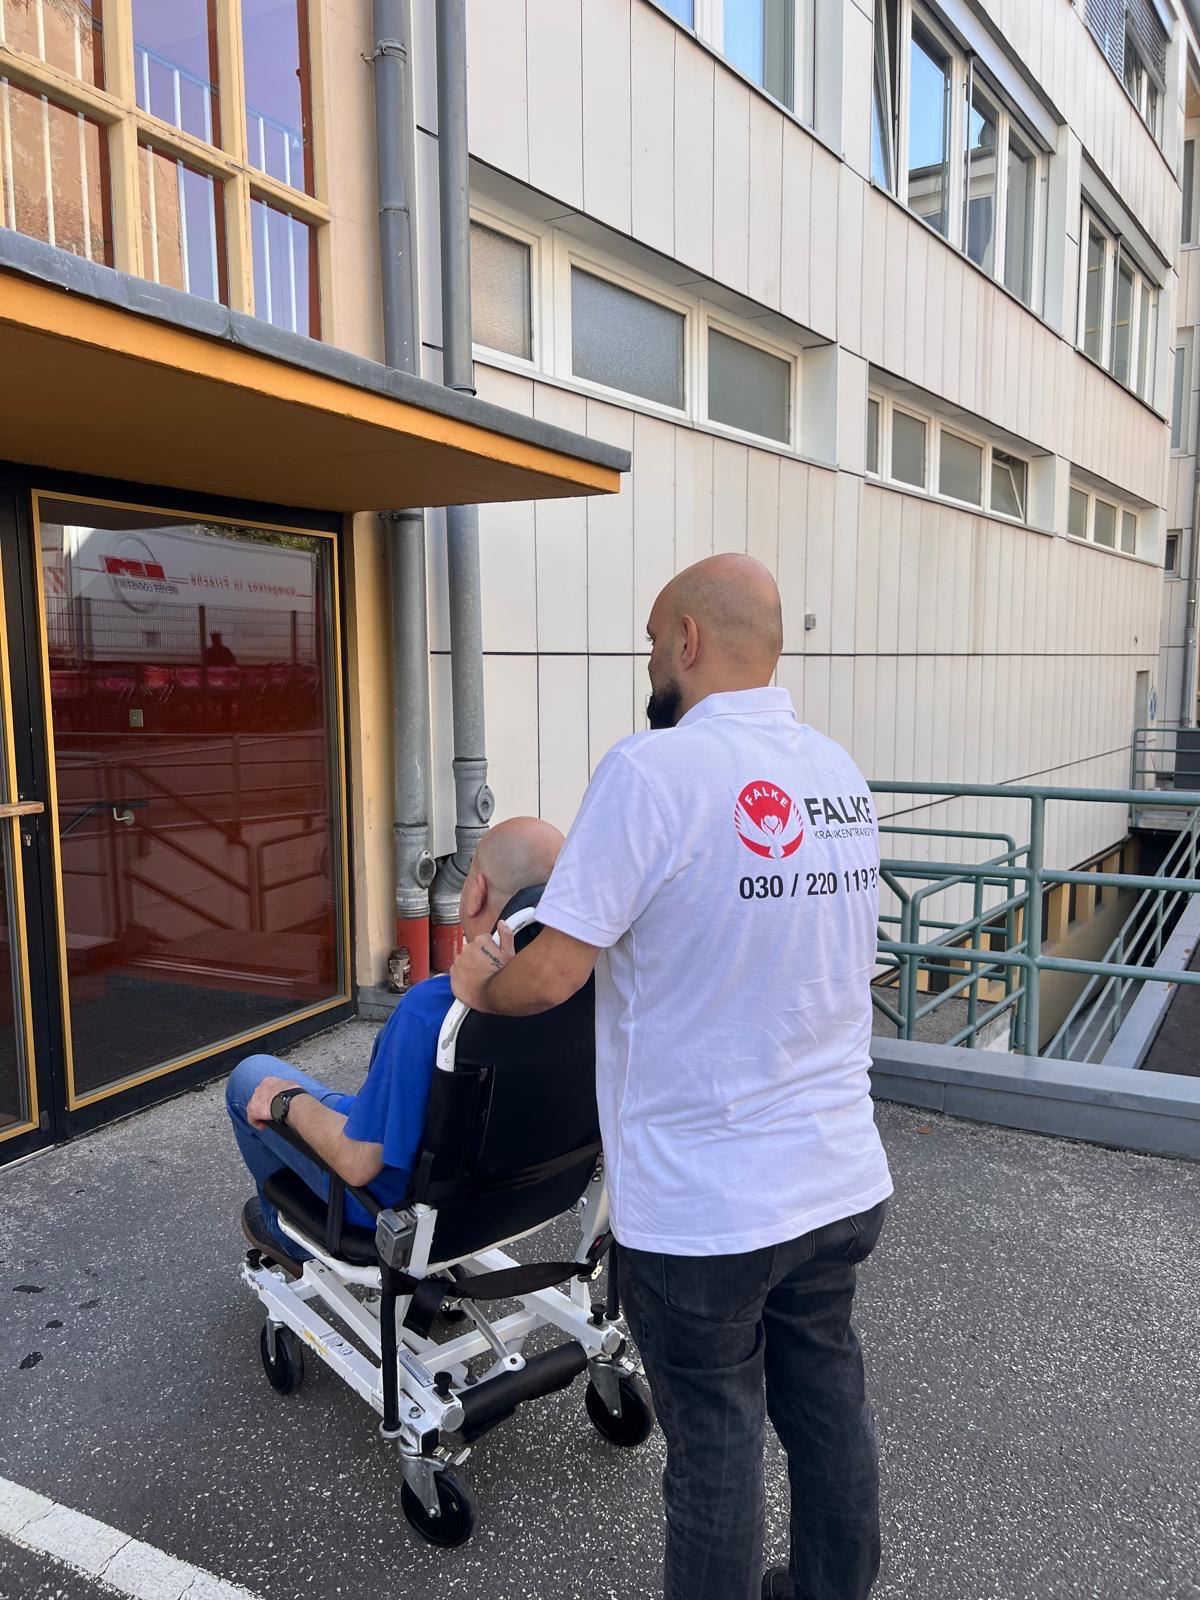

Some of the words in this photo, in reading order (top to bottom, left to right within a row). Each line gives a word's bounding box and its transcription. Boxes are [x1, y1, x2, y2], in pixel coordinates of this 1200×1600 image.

[744, 786, 789, 809] FALKE
[803, 795, 873, 826] FALKE
[739, 875, 784, 900] 030
[790, 873, 799, 898] /
[805, 872, 838, 896] 220
